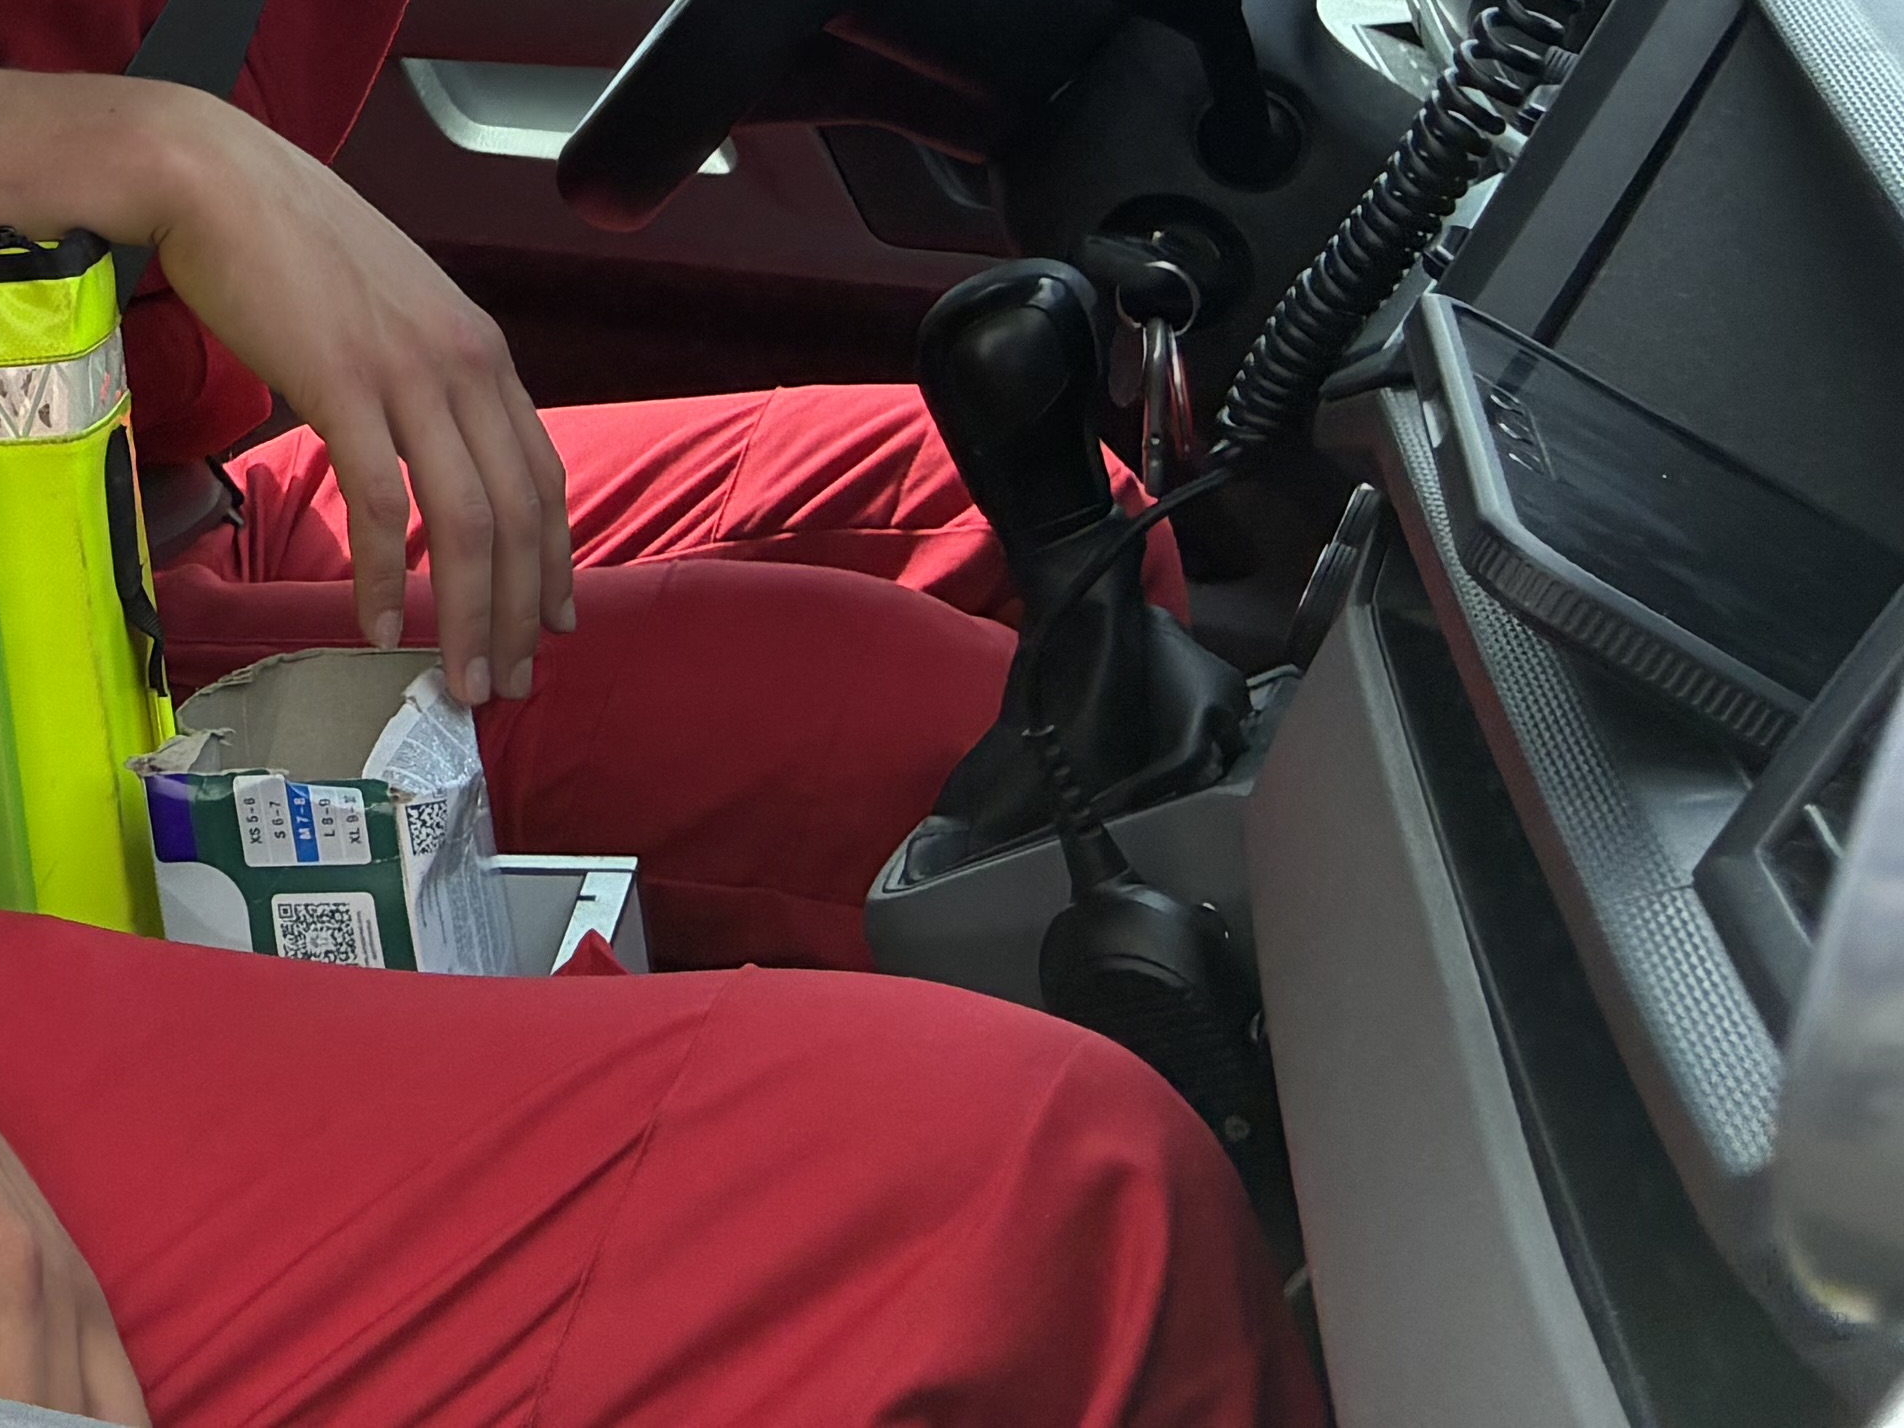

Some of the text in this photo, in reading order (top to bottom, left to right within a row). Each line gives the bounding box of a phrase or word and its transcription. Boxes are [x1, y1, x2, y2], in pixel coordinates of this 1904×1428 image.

[248, 827, 263, 844] XS
[274, 830, 286, 840] S
[298, 827, 312, 841] M
[323, 829, 335, 837] L
[348, 827, 362, 845] XL
